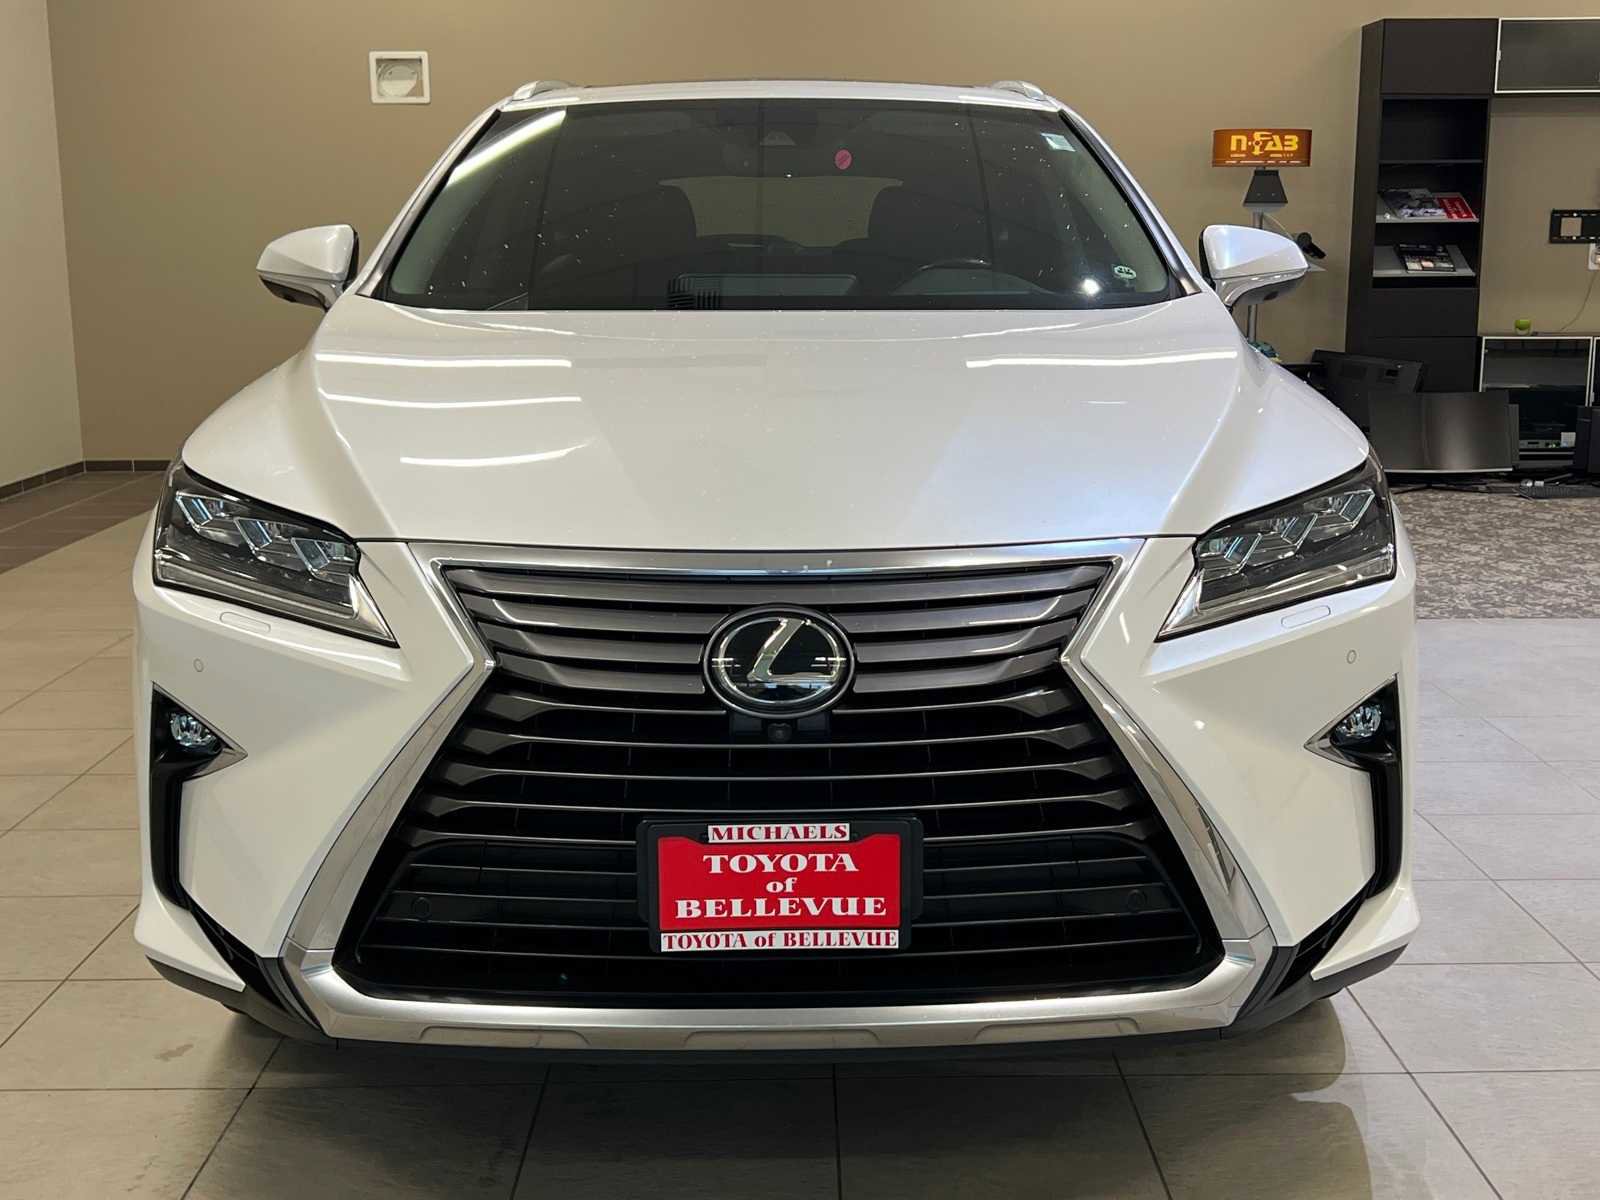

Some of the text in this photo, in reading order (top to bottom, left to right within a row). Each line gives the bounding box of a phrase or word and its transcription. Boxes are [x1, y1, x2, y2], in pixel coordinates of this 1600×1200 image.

[711, 824, 848, 841] MICHAELS
[703, 853, 859, 874] TOYOTA
[765, 877, 798, 894] of
[675, 897, 887, 919] BELLEVUE
[663, 929, 898, 950] TOYOTA of BELLEVUE
